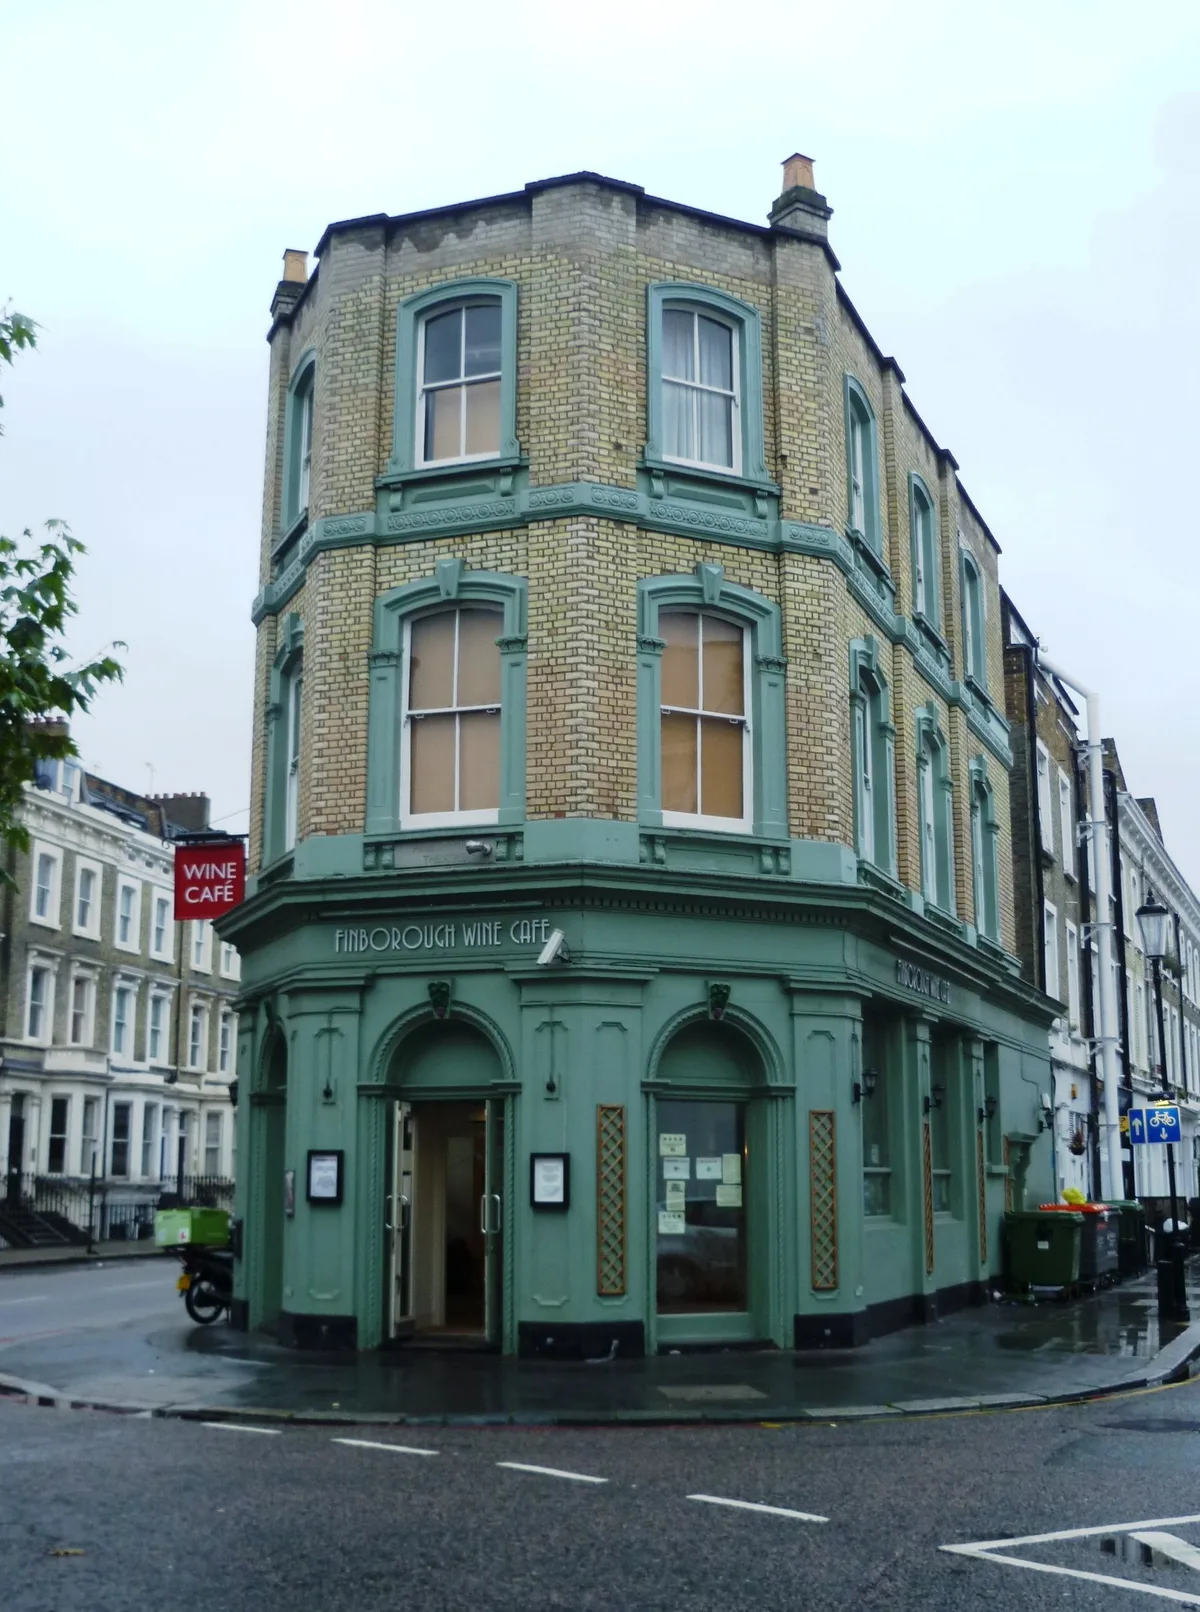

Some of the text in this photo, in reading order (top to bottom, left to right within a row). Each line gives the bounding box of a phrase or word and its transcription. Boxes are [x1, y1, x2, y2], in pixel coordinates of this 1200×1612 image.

[183, 862, 237, 880] WINE
[185, 880, 234, 904] CAFÉ
[335, 919, 550, 953] FINBOROUGH WINE CAFE
